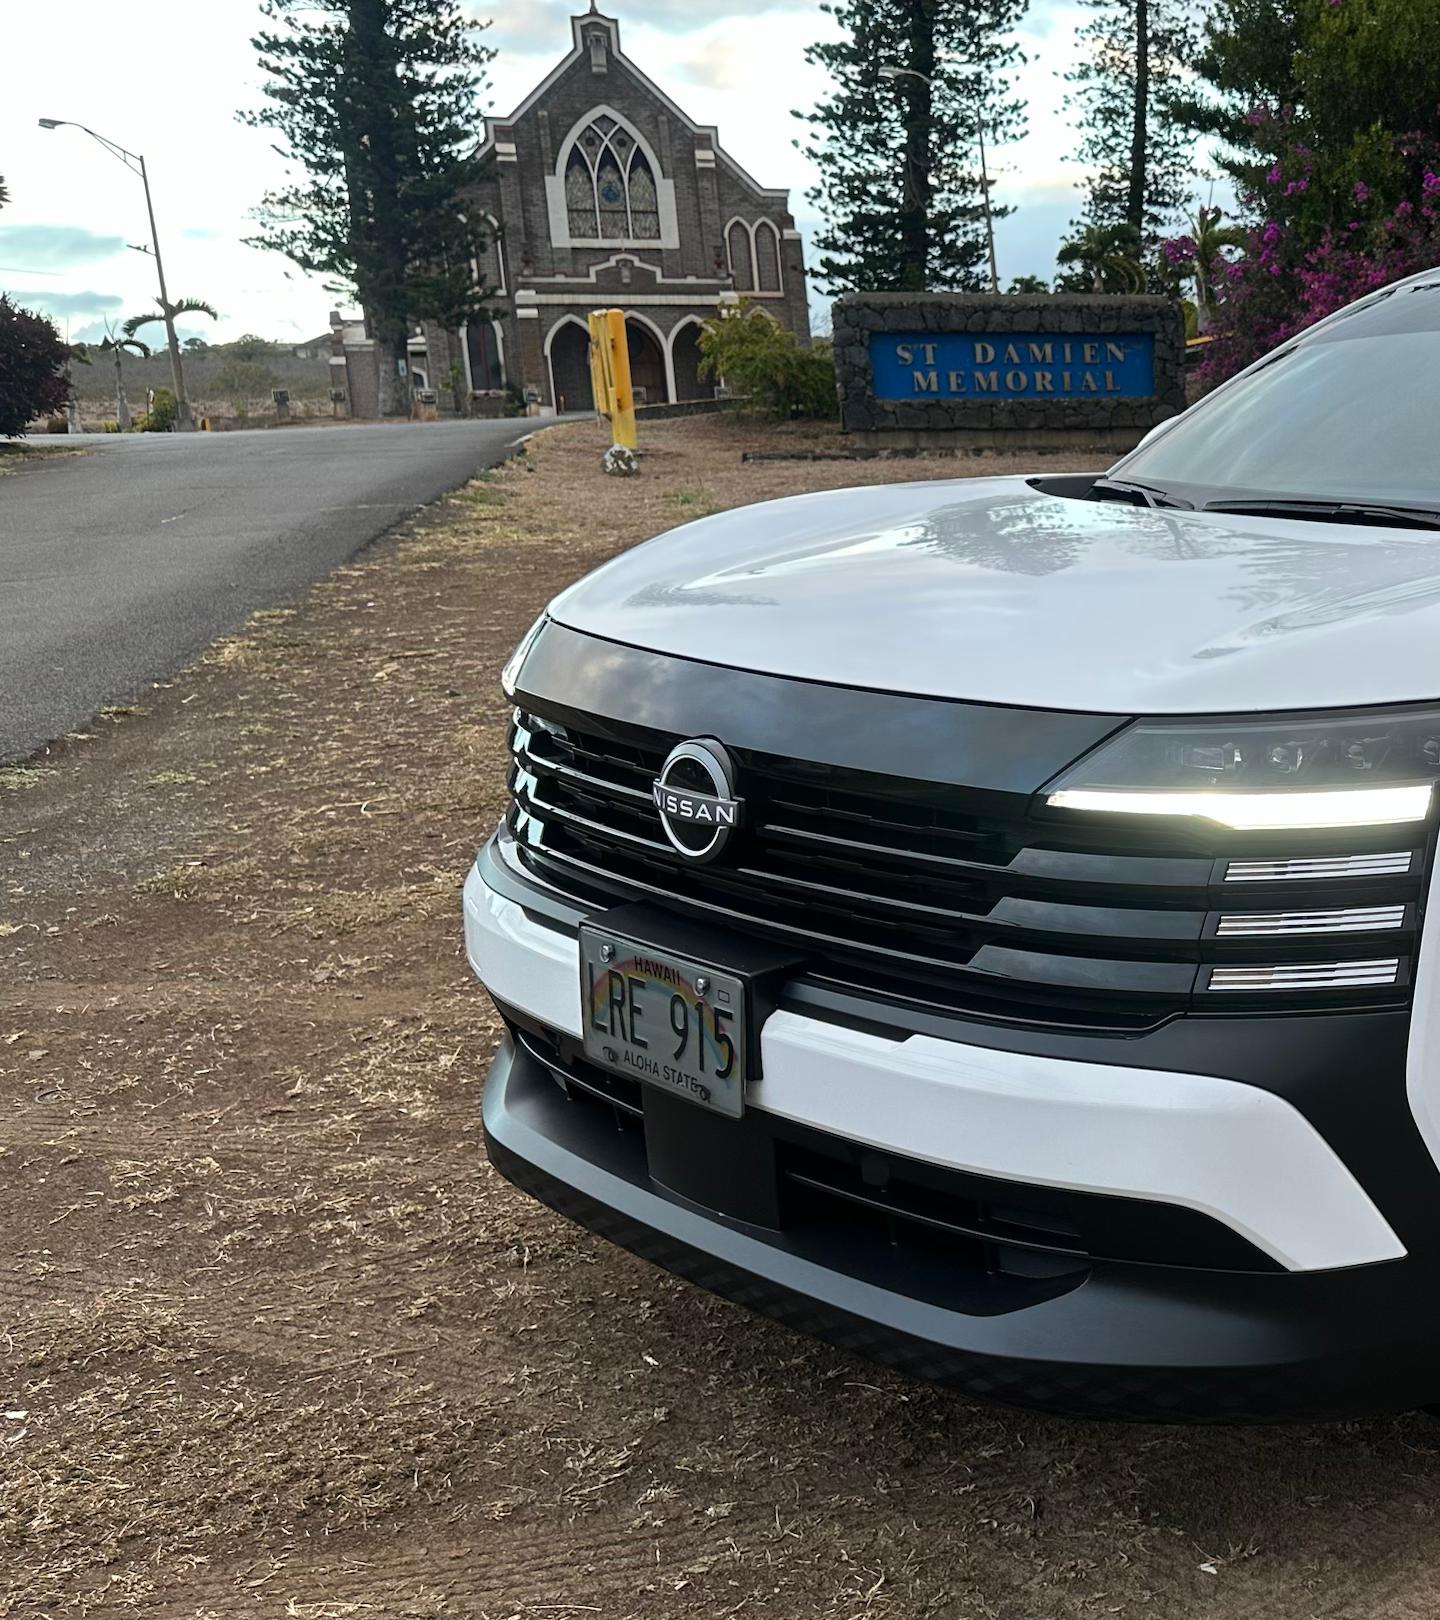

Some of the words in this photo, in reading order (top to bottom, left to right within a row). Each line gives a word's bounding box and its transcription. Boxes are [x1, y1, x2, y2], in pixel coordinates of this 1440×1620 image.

[896, 343, 937, 366] ST
[975, 342, 1125, 365] DAMIEN
[913, 370, 1121, 393] MEMORIAL
[653, 785, 734, 824] NISSAN
[634, 956, 680, 985] HAWAII
[588, 962, 648, 1049] LRE
[670, 994, 734, 1080] 915
[624, 1050, 659, 1077] ALOHA
[663, 1065, 700, 1092] STATE
